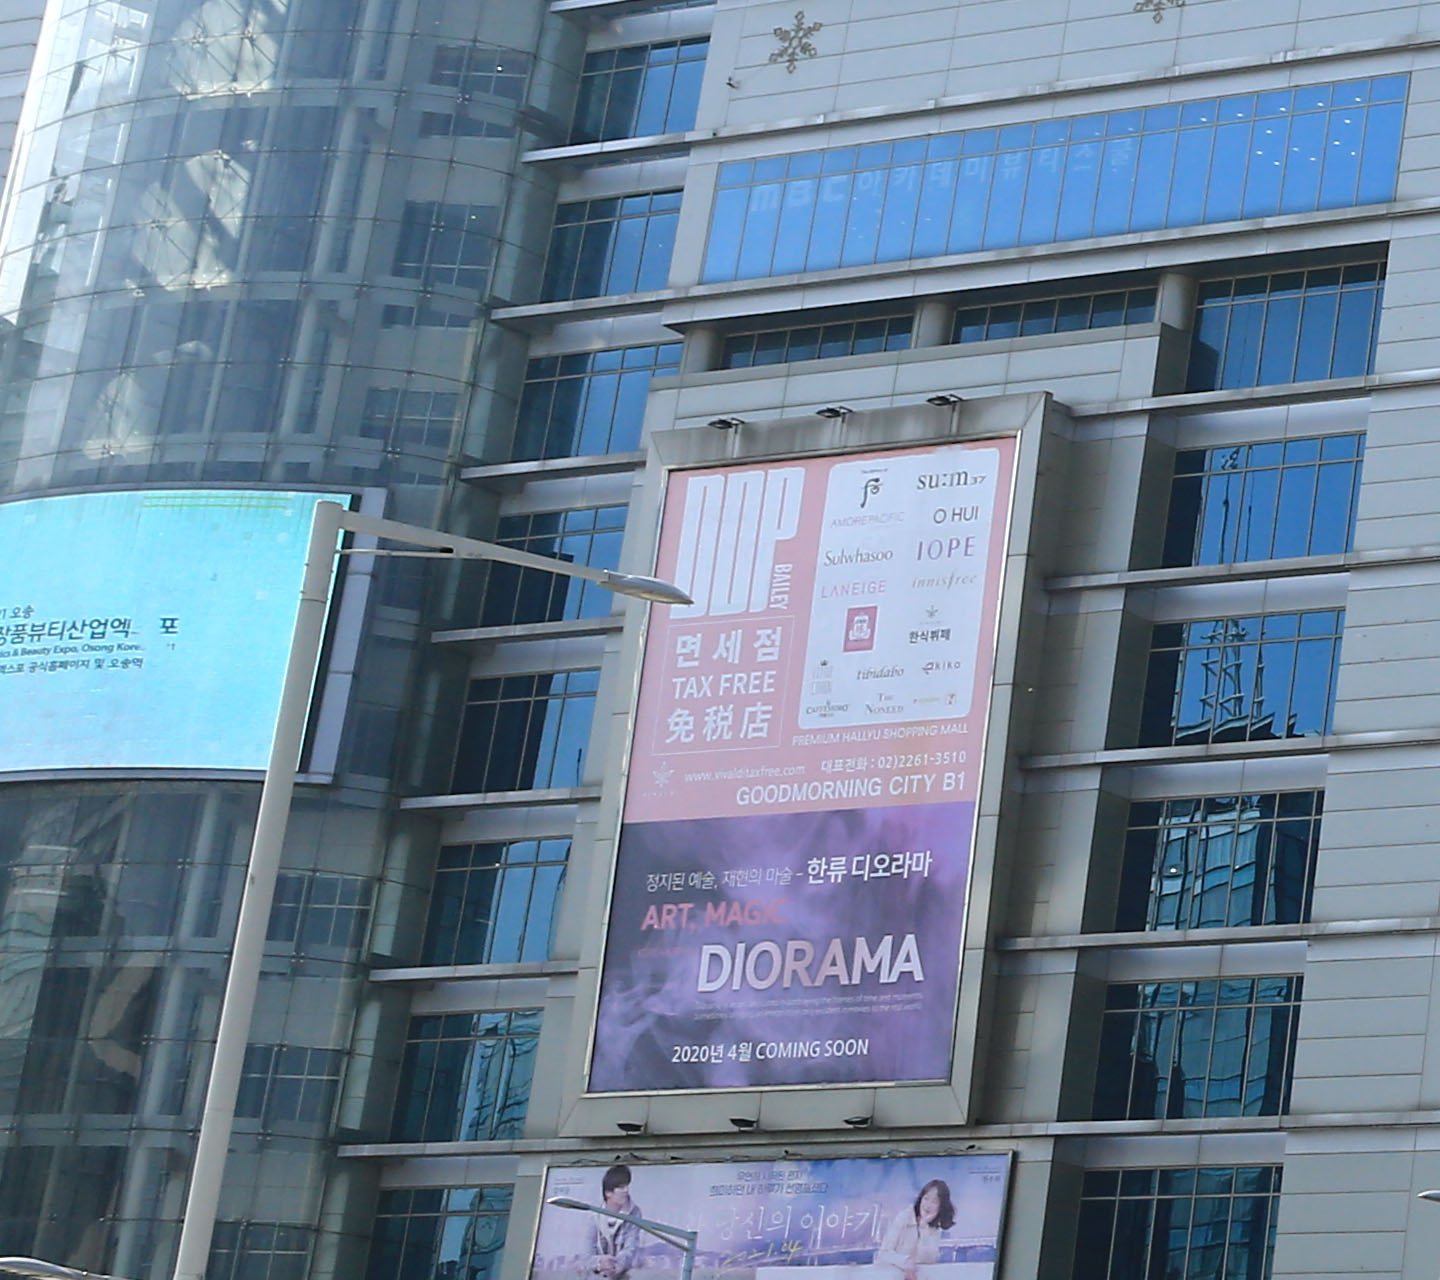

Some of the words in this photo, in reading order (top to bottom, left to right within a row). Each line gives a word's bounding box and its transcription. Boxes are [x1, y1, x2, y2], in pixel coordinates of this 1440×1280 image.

[824, 549, 893, 567] Sulwhasoo
[916, 536, 977, 561] IOPE
[768, 563, 793, 610] BAILEY
[912, 572, 978, 590] innisfree
[672, 675, 713, 699] TAX
[719, 670, 777, 696] FREE
[940, 723, 968, 736] MALL
[737, 777, 881, 806] GOODMORNING
[889, 774, 935, 795] CITY
[943, 772, 965, 791] B1
[807, 856, 847, 885] 한류
[851, 850, 933, 882] 디오라마
[641, 903, 697, 932] ART,
[696, 933, 925, 993] DIORAMA
[672, 1044, 723, 1063] 2020년
[755, 1040, 820, 1059] COMING
[823, 1039, 869, 1056] SOON
